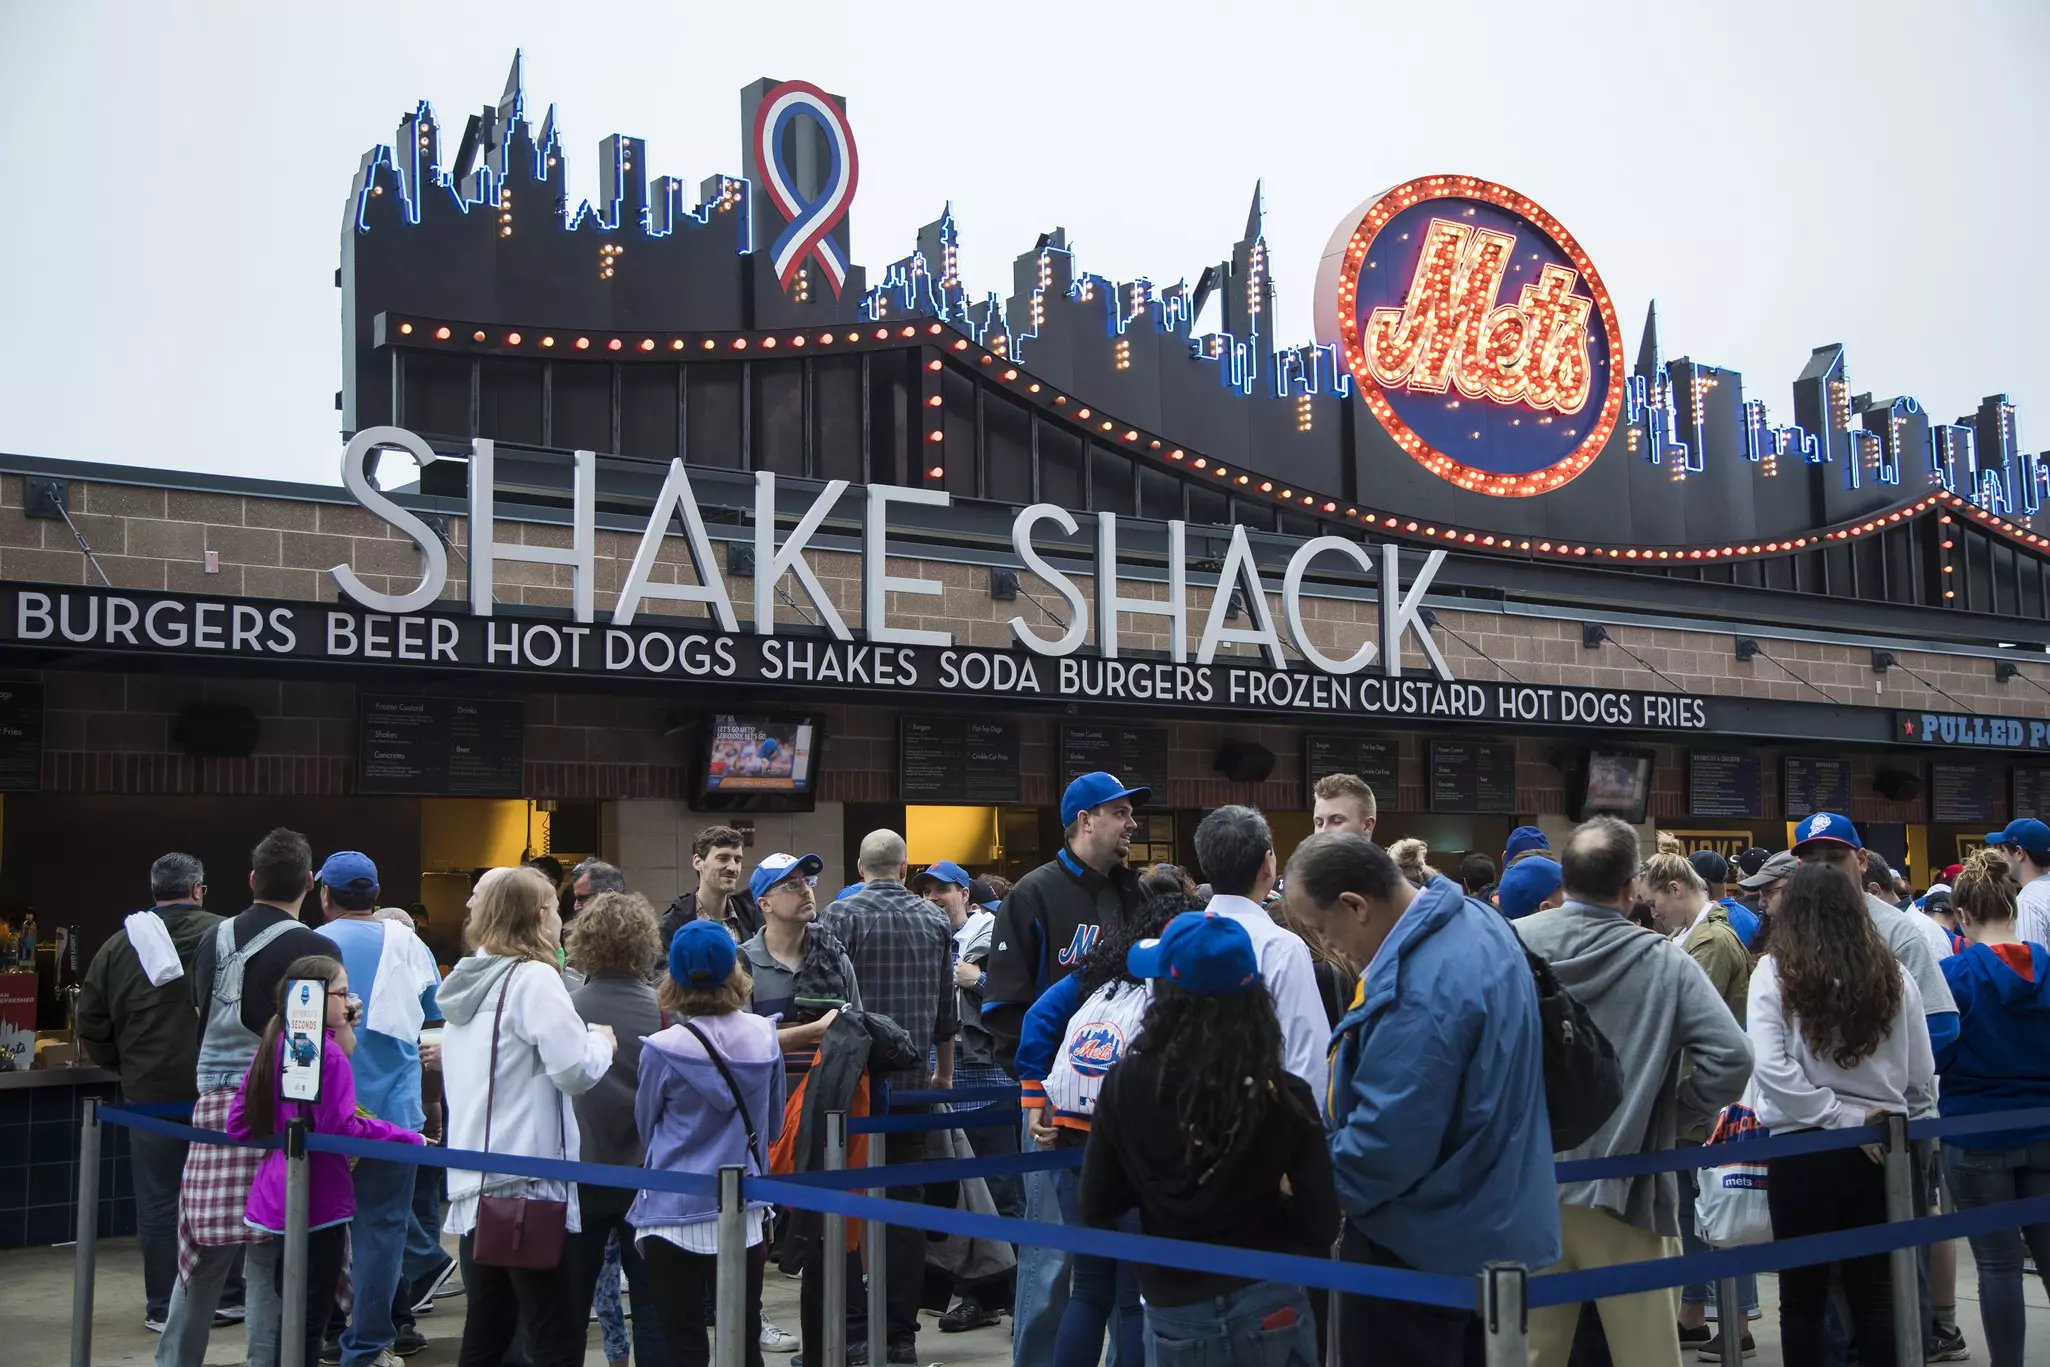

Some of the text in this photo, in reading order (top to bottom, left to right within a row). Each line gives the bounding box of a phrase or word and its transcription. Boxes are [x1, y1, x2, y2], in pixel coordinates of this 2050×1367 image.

[1363, 217, 1592, 415] Mets
[328, 425, 1454, 681] SHAKE SHACK
[17, 591, 1706, 728] BURGERS BEER HOT DOGS SHAKES SODA BURGERS FROZEN CUSTARD HOT DOGS FRIES
[1921, 714, 2050, 748] PULLED P
[291, 1019, 317, 1030] SECONDS
[1074, 1039, 1115, 1060] Mets
